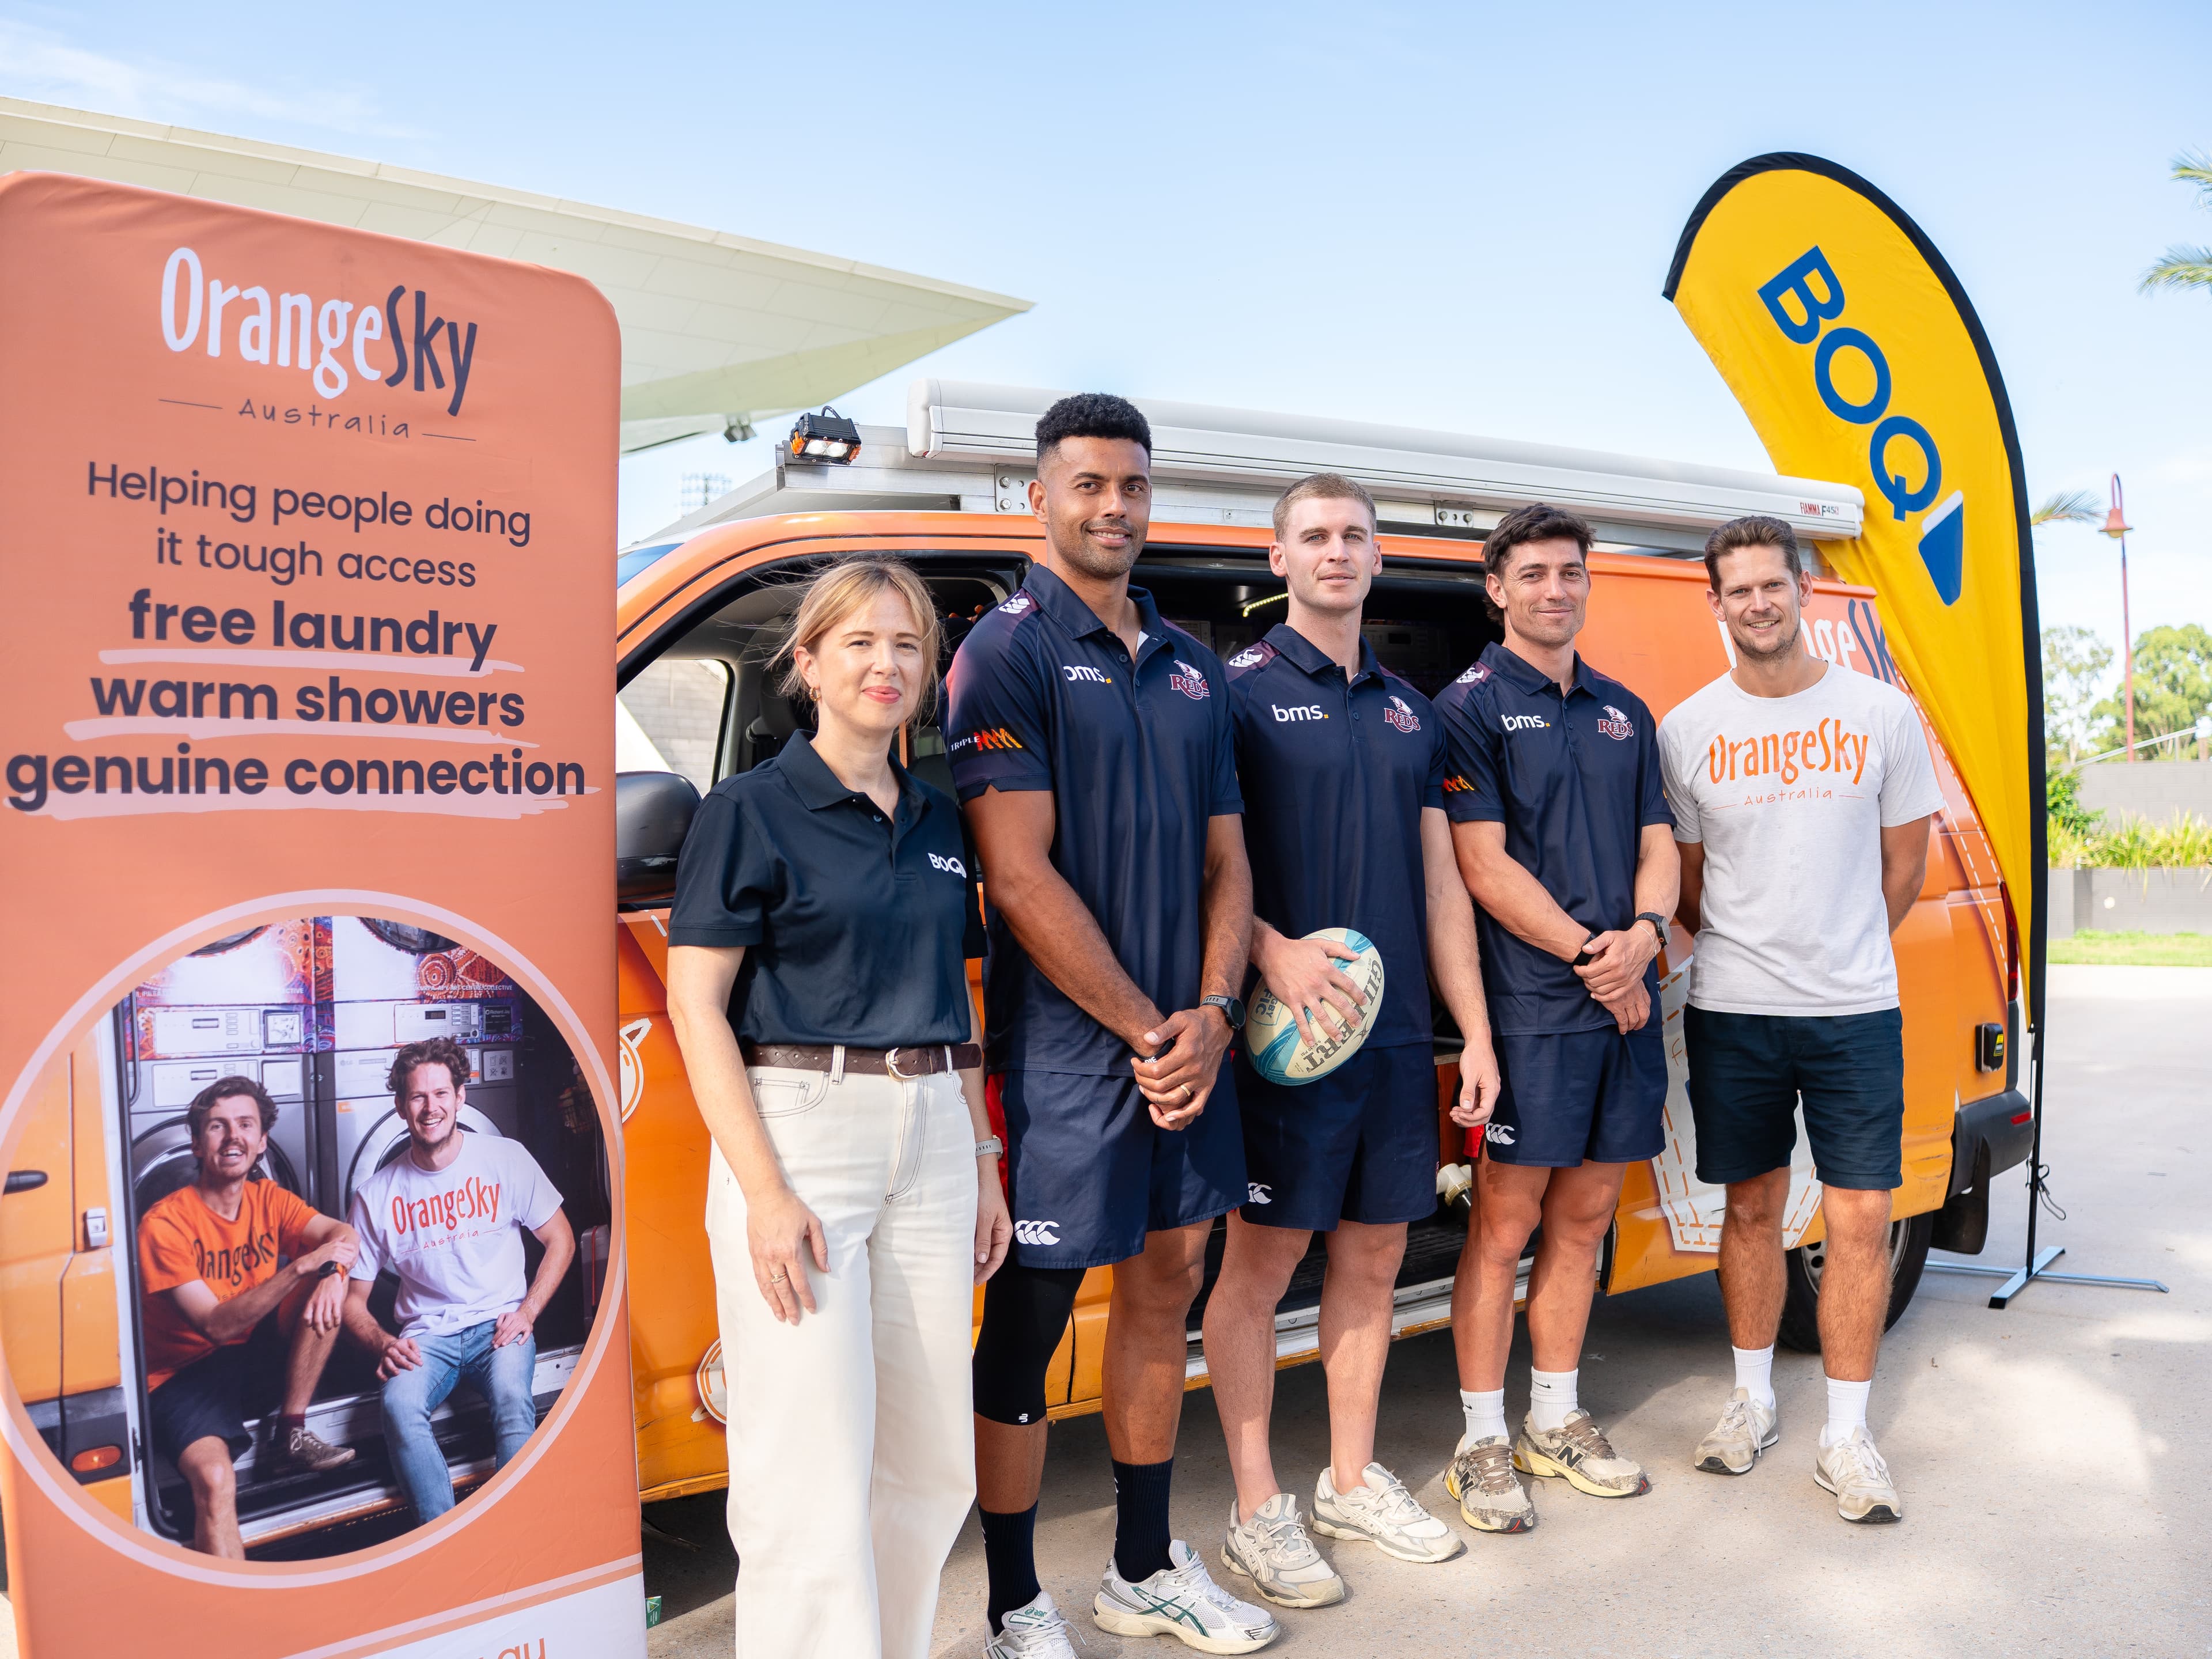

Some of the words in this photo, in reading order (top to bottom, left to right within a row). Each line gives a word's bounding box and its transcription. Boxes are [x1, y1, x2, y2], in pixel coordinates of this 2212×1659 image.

[161, 247, 478, 416] OrangeSky
[1758, 244, 1941, 521] BOQ
[238, 399, 410, 439] Australia
[88, 461, 256, 523] Helping
[273, 488, 412, 533] people
[426, 497, 531, 547] doing
[157, 528, 183, 566] it
[197, 534, 323, 586] tough
[337, 553, 476, 588] access
[128, 589, 256, 645] free
[273, 600, 498, 672] laundry
[90, 677, 278, 721] warm
[296, 676, 525, 726] showers
[1272, 704, 1329, 722] bms.
[1384, 707, 1421, 733] REDS
[1501, 714, 1551, 732] bms.
[951, 736, 981, 751] TRIPLE
[1597, 719, 1634, 741] REDS
[1709, 717, 1869, 785] OrangeSky
[5, 742, 268, 812] genuine
[284, 748, 585, 795] connection
[1744, 786, 1833, 805] Australia
[928, 853, 963, 874] BOQ
[1303, 960, 1382, 1073] GILERT
[392, 1176, 500, 1236] OrangeSky
